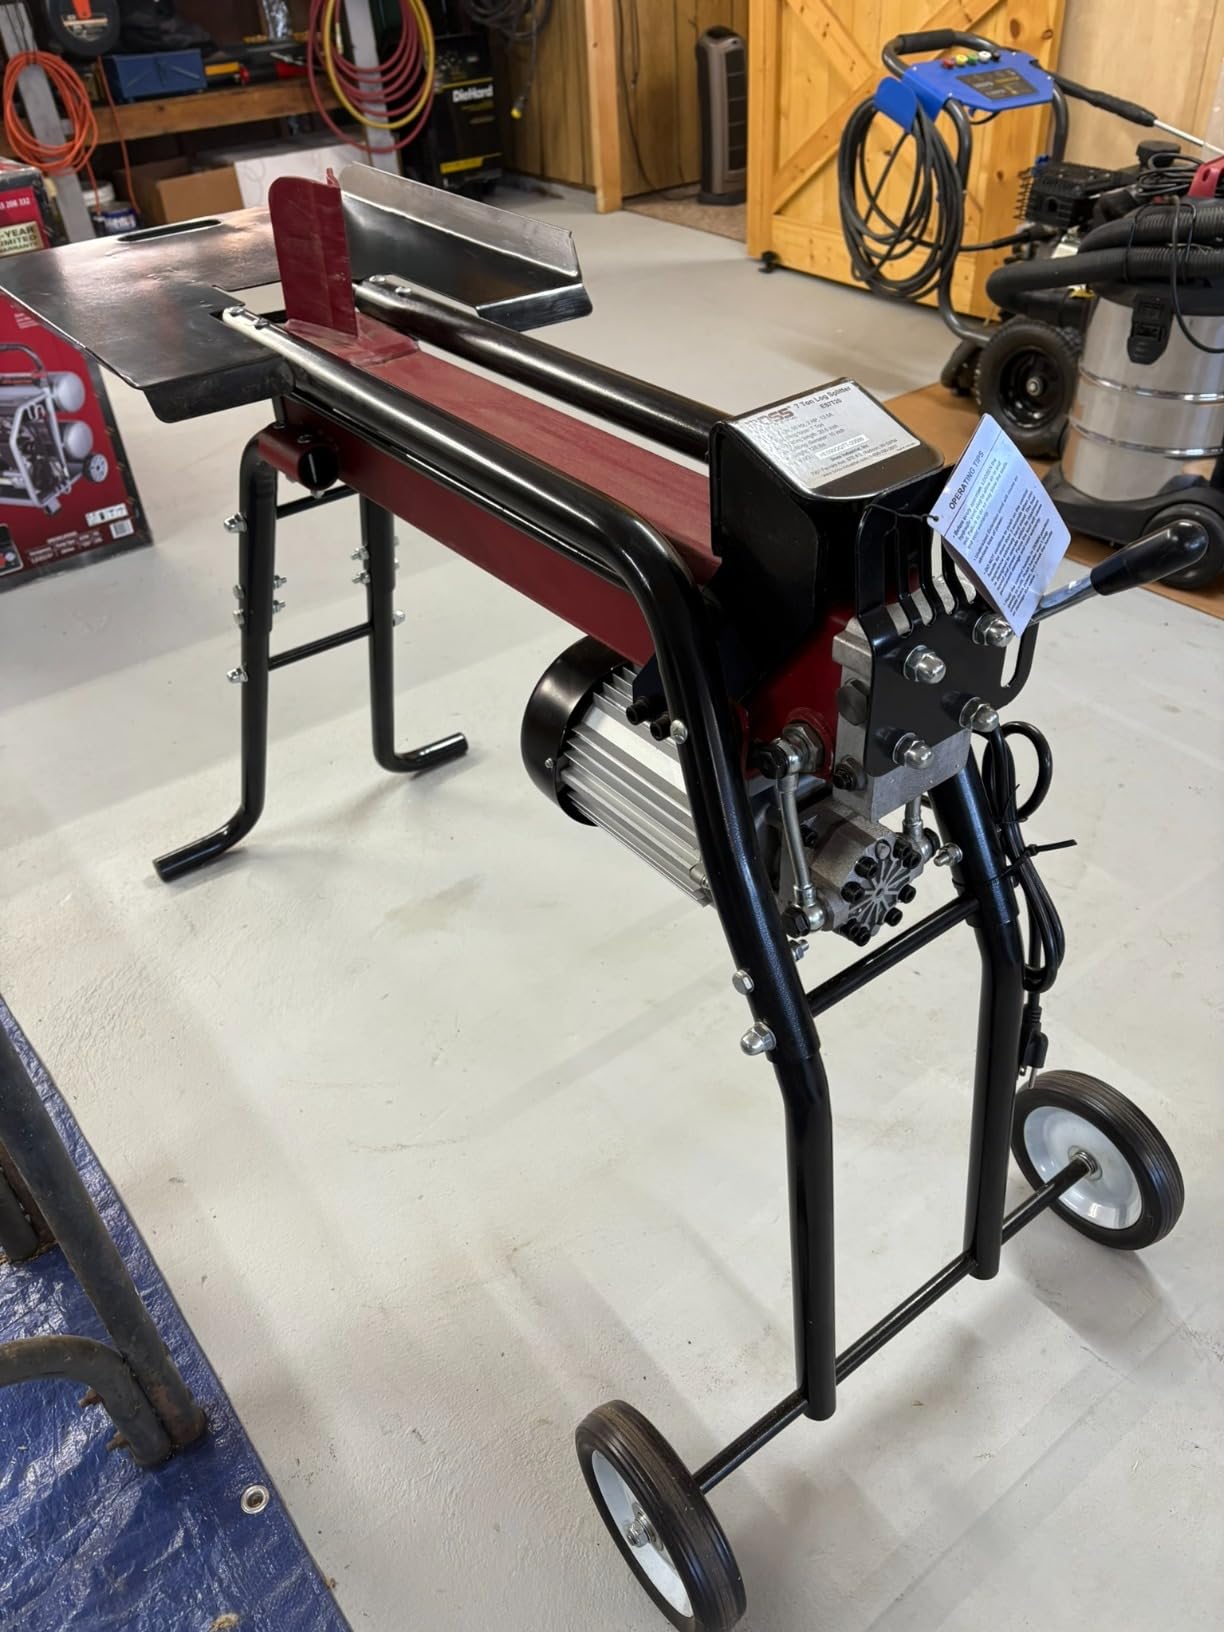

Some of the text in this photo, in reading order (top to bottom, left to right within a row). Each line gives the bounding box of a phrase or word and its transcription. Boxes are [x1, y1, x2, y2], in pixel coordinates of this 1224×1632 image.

[799, 399, 815, 407] Ton
[813, 394, 830, 402] Log
[949, 450, 984, 510] OPERATING TIPS
